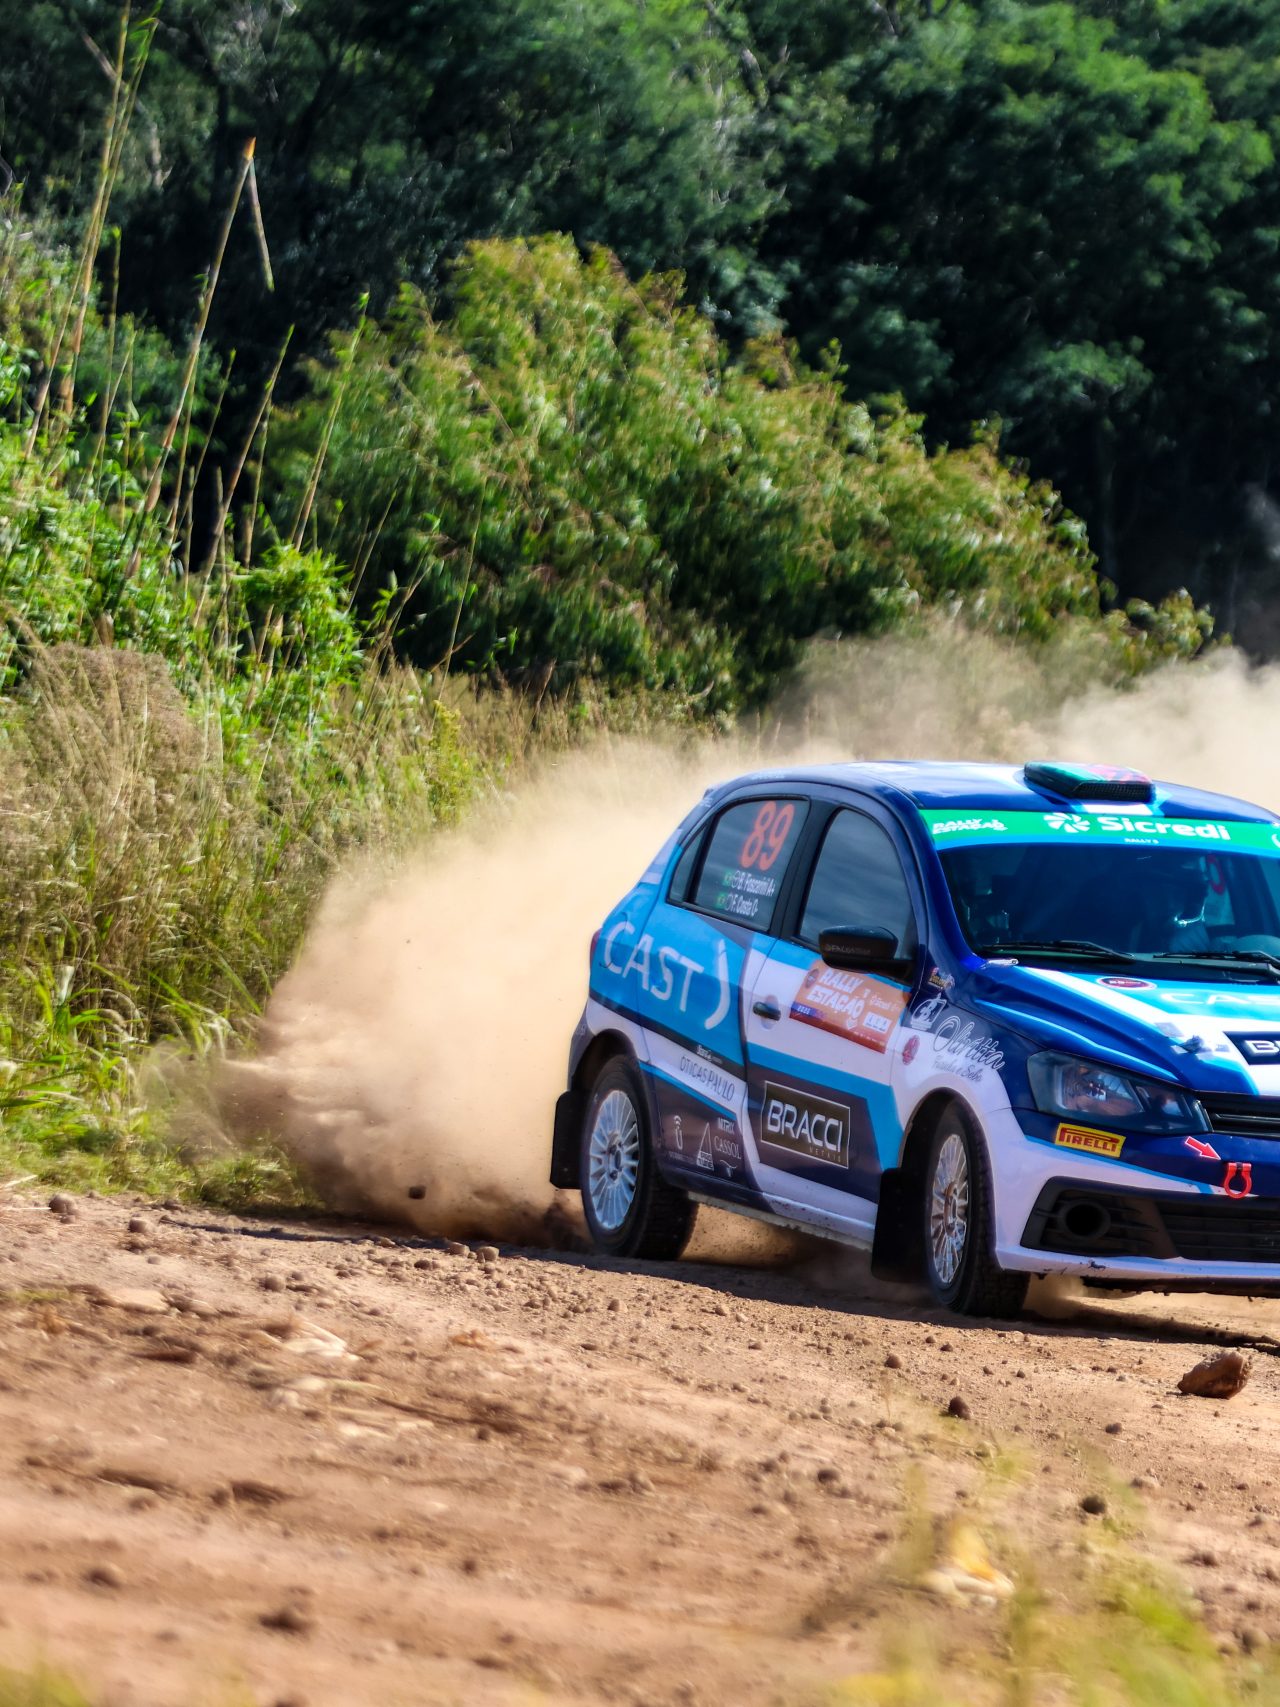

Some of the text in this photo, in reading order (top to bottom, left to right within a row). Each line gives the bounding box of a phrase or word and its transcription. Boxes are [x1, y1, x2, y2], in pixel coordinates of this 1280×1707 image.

[740, 800, 795, 871] 89
[1099, 816, 1231, 840] Sicredi
[820, 967, 863, 994] RALLY
[806, 984, 865, 1019] ESTAÇÃO
[767, 1099, 843, 1152] BRACCI
[1058, 1127, 1120, 1152] PIRELLI
